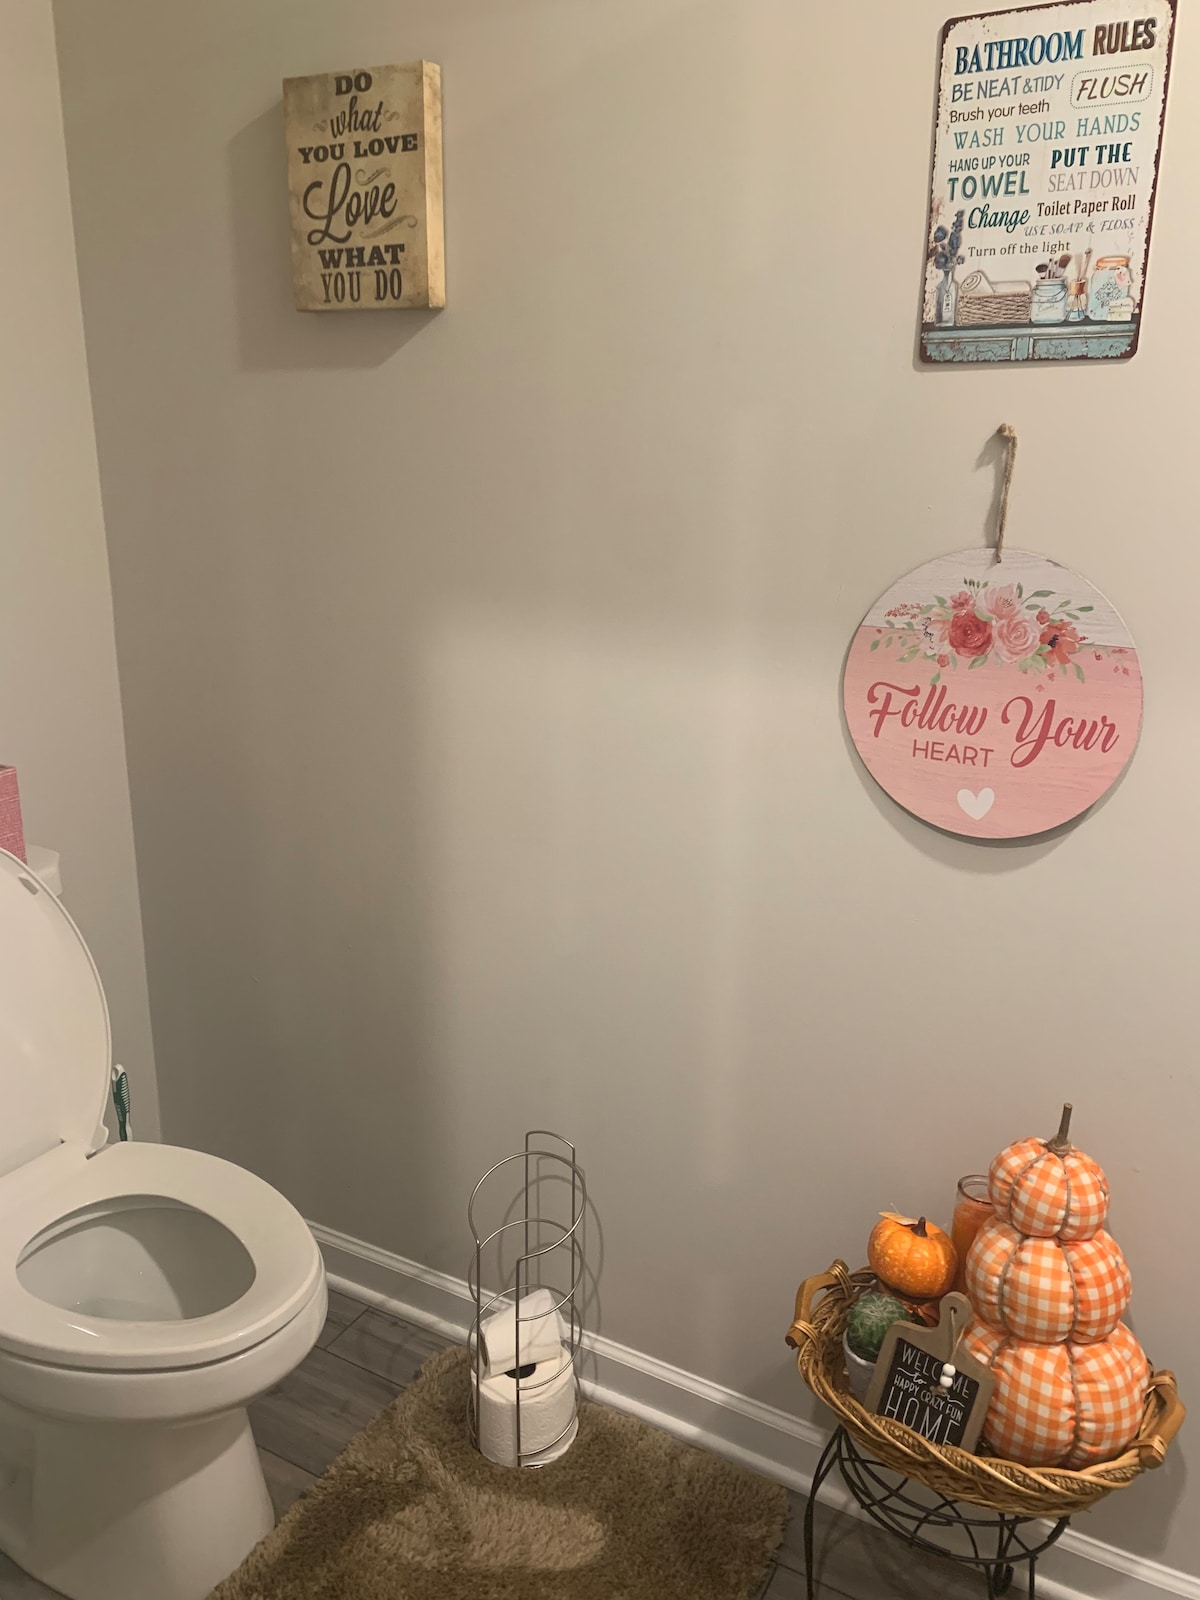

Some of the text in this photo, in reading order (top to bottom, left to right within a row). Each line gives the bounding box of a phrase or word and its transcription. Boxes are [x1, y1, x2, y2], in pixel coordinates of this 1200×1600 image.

[953, 17, 1158, 75] BATHROOM RULES
[334, 72, 373, 96] DO
[951, 82, 974, 103] BE
[976, 75, 1022, 100] NEAT
[1076, 72, 1148, 102] FLUSH
[330, 95, 384, 139] what
[950, 99, 1050, 123] Brush your teeth
[953, 112, 1142, 150] WASH YOUR HANDS
[298, 133, 418, 164] YOU LOVE
[949, 153, 1031, 173] HANG UP YOUR
[1050, 142, 1133, 169] PUT THE
[947, 170, 1030, 202] TOWEL
[1048, 166, 1140, 193] SEAT DOWN
[303, 162, 398, 245] Love
[967, 194, 1136, 233] Change Toilet Paper Roll
[1023, 223, 1047, 237] USE
[1048, 221, 1083, 235] SOAP
[1100, 218, 1136, 232] FLOSS
[318, 244, 405, 269] WHAT
[968, 240, 1071, 257] Turn off the light
[321, 268, 402, 303] YOU DO
[867, 681, 1120, 768] Follow Your
[912, 739, 994, 767] HEART
[902, 1344, 971, 1399] WELCME
[894, 1374, 920, 1397] HAPPY
[920, 1389, 945, 1412] CRAZY
[945, 1404, 963, 1422] FUN
